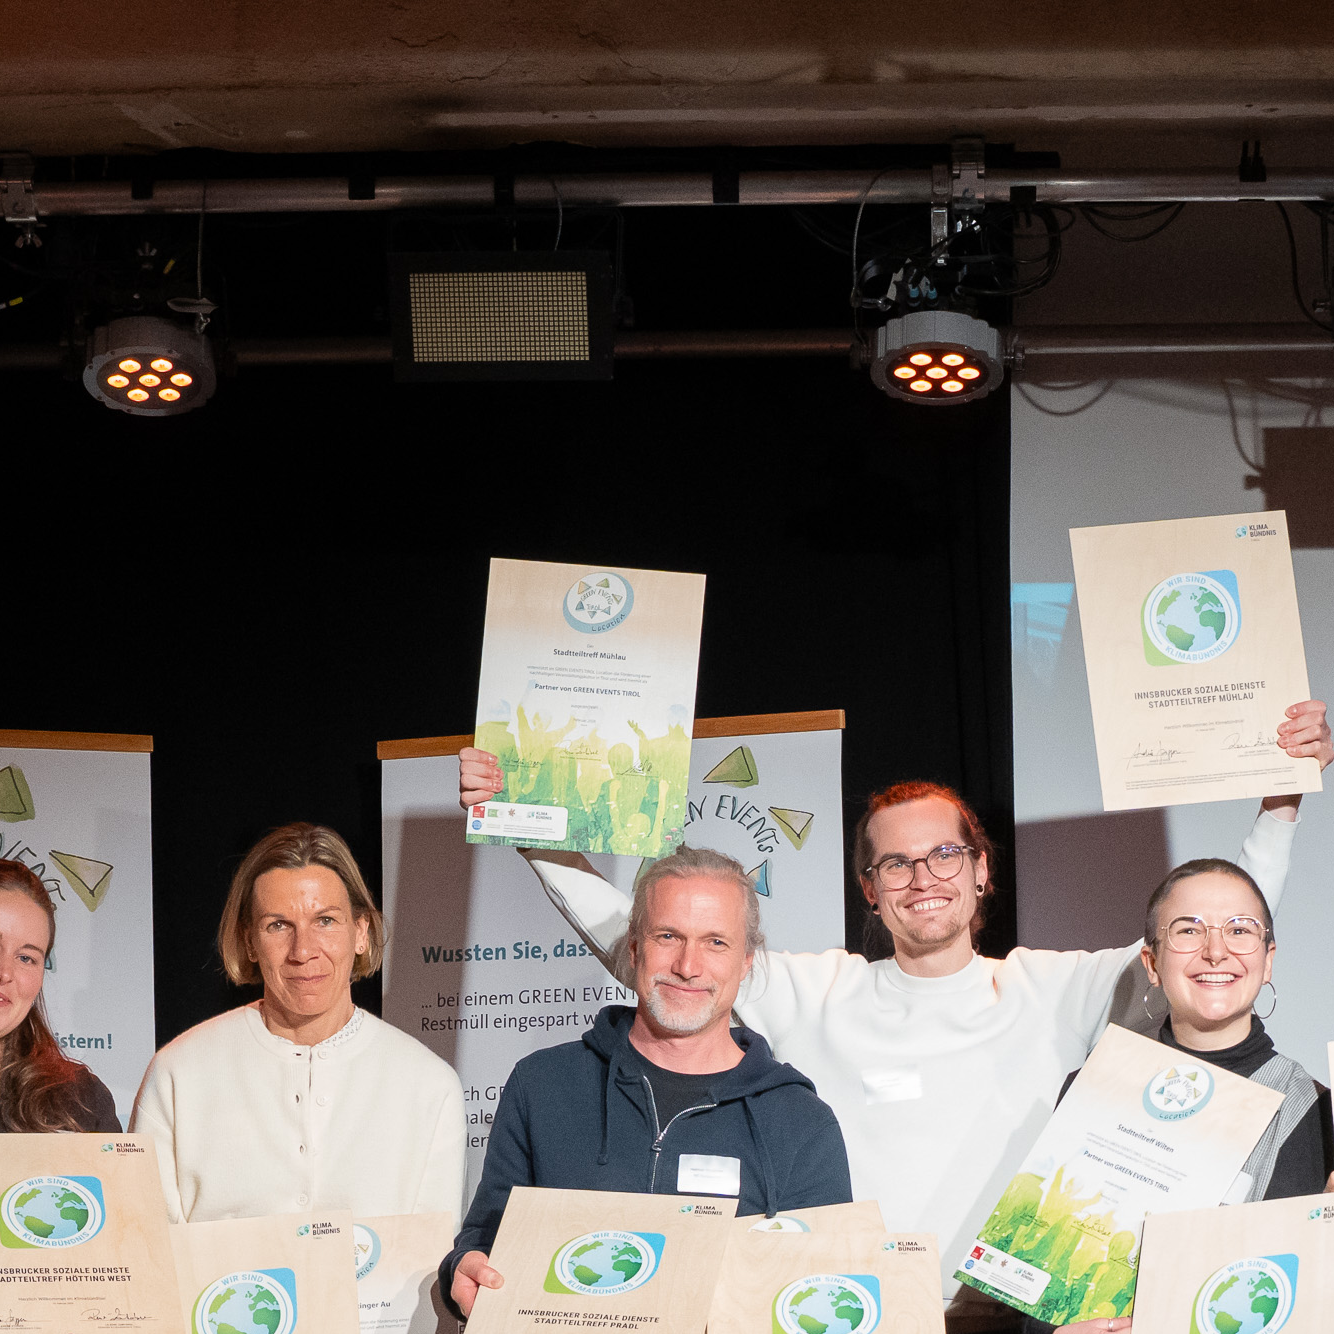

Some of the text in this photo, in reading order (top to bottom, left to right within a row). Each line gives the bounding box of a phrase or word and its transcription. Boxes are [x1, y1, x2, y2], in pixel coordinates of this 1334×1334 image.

[1249, 530, 1276, 538] BÜNDNIS
[1167, 576, 1206, 588] WIR SIND
[554, 649, 598, 658] Stadtteiltreff
[1165, 640, 1228, 662] KLIMABÜNDNIS
[560, 685, 571, 693] von
[1135, 681, 1265, 699] INNSBRUCKER SOZIALE DIENSTE
[1149, 693, 1253, 708] STADTTEILTREFF MÜHLAU
[715, 795, 780, 853] EVENTS
[422, 940, 548, 963] Wussten Sie,
[437, 992, 460, 1008] bei
[464, 991, 514, 1006] einem
[518, 988, 576, 1004] GREEN
[421, 1011, 579, 1032] Restmüll eingespart
[1154, 1139, 1174, 1152] Wilten
[26, 1178, 69, 1187] WIR SIND
[1113, 1164, 1134, 1177] GREEN
[1155, 1182, 1169, 1192] TIROL
[312, 1228, 341, 1236] BÜNDNIS
[613, 1232, 634, 1241] SIND
[22, 1232, 90, 1247] KLIMABÜNDNIS
[1226, 1260, 1267, 1273] WIR SIND
[222, 1274, 263, 1286] WIR SIND
[804, 1277, 821, 1285] WIR
[566, 1280, 634, 1294] KLIMABÜNDNIS
[535, 1318, 607, 1327] STADTTEILTREFF
